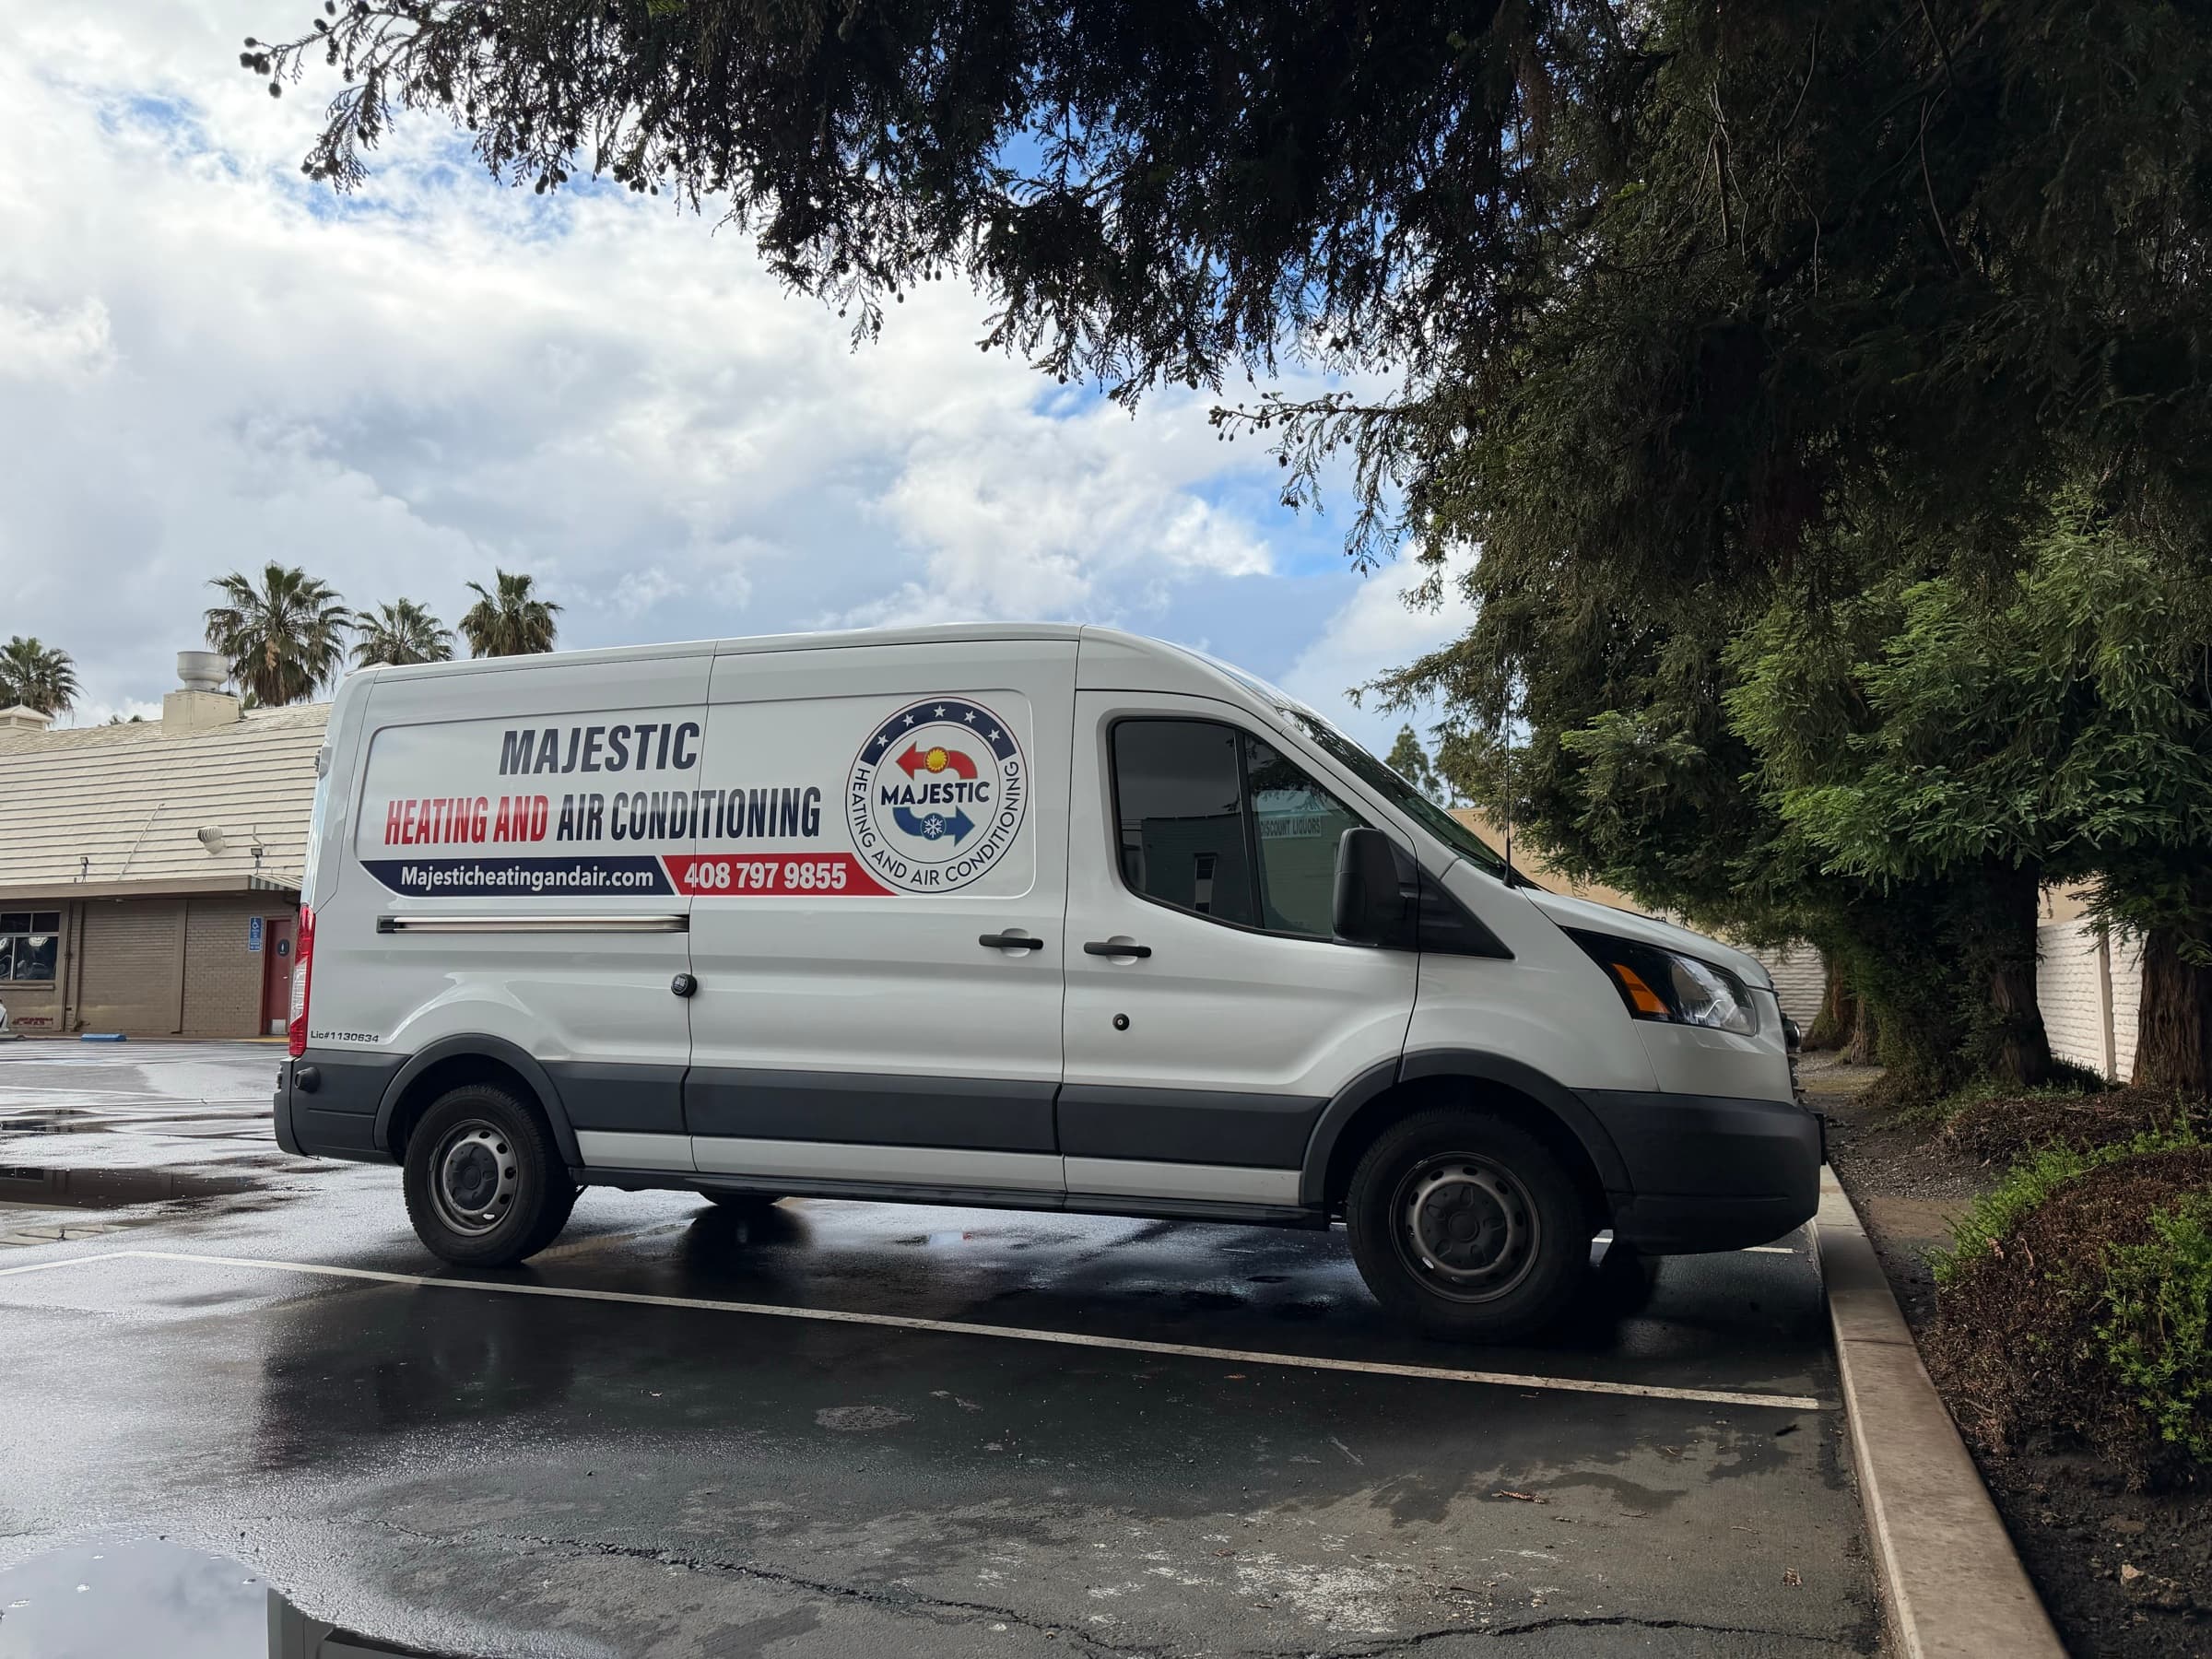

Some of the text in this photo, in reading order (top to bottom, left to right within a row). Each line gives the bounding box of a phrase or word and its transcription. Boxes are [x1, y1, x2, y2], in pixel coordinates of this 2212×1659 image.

[499, 722, 700, 776] MAJESTIC
[880, 782, 991, 806] MAJESTIC
[384, 786, 821, 845] HEATING AND AIR CONDITIONING
[851, 761, 1021, 886] HEATING AND AIR CONDITIONING
[1292, 818, 1321, 834] LIQUORS
[400, 865, 654, 891] Majesticheatingandair.com
[684, 862, 847, 889] 408 797 9855
[310, 1030, 379, 1043] Lic#1130634
